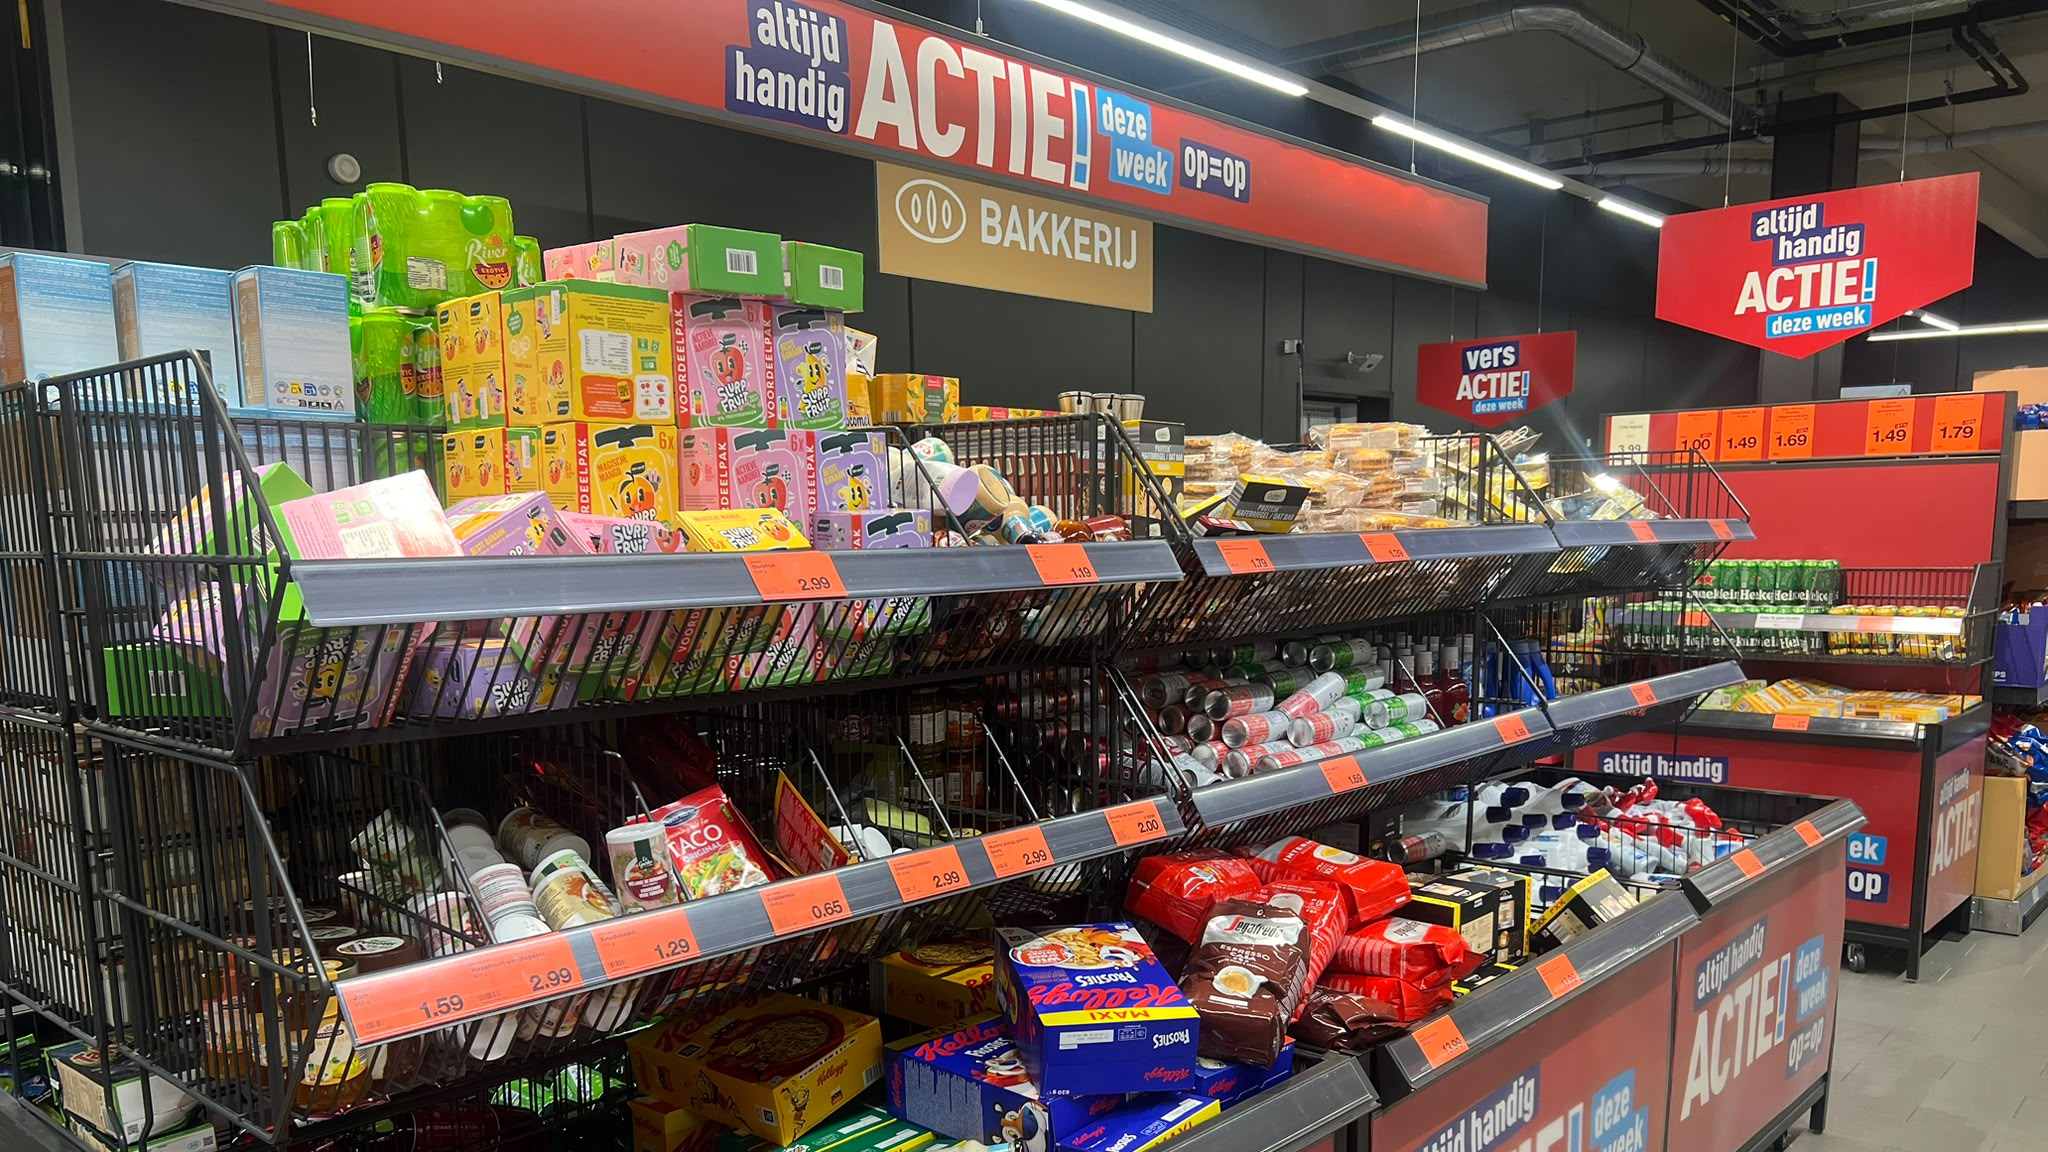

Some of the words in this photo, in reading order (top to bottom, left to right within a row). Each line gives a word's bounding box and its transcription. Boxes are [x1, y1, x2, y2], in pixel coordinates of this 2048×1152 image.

[755, 2, 840, 66] altijd
[735, 51, 846, 132] handig
[855, 19, 1091, 191] ACTIE!
[1101, 97, 1148, 141] deze
[1116, 146, 1168, 187] week
[1184, 145, 1246, 198] op=op
[1756, 203, 1818, 236] altijd
[980, 198, 1138, 270] BAKKERIJ
[1778, 227, 1861, 261] handig
[466, 238, 508, 270] River
[480, 266, 505, 275] EXOTIC
[1734, 257, 1877, 316] ACTIE!
[747, 306, 761, 323] 6x
[1772, 313, 1812, 336] deze
[1816, 306, 1865, 330] week
[830, 316, 842, 333] 6x
[673, 308, 690, 415] VOORDEELPAK
[1466, 344, 1516, 370] vers
[764, 317, 776, 420] VOORDEELPAK
[717, 379, 747, 398] SLURP
[1456, 371, 1529, 400] ACTIE!
[801, 387, 829, 406] SLURP
[1475, 401, 1496, 415] deze
[1498, 397, 1524, 413] week
[659, 432, 675, 450] 6x
[1776, 434, 1807, 447] 1.69
[1872, 429, 1907, 443] 1.49
[1940, 426, 1974, 439] 1.79
[790, 434, 804, 452] 6x
[872, 437, 884, 453] 6x
[1682, 439, 1711, 450] 1.00
[1726, 436, 1757, 450] 1.49
[597, 455, 628, 473] MAGISCHE
[599, 468, 622, 484] MANGO
[1257, 504, 1281, 513] PROTEIN
[612, 524, 649, 542] SLURP
[917, 516, 930, 533] 6x
[709, 538, 728, 550] 6x
[719, 526, 752, 544] SLURP
[1070, 566, 1092, 579] 1.19
[1251, 558, 1268, 569] 1.79
[798, 576, 831, 592] 2.99
[1603, 753, 1652, 776] altijd
[1657, 756, 1723, 784] handig
[1137, 819, 1160, 834] 2.00
[667, 824, 723, 858] TACO
[682, 842, 722, 863] ORIGINAL
[1022, 849, 1048, 866] 2.99
[932, 871, 961, 889] 2.99
[811, 900, 843, 920] 0.65
[1224, 915, 1283, 938] Segafred
[654, 938, 691, 960] 1.29
[1220, 944, 1270, 961] ESPRESSO
[1230, 952, 1256, 961] CASA
[1697, 952, 1726, 1000] altijd
[1729, 921, 1767, 983] handig
[1796, 945, 1821, 983] deze
[529, 967, 573, 992] 2.99
[1075, 972, 1137, 987] FROSTIES
[353, 992, 369, 1001] Jam
[1799, 974, 1827, 1016] week
[419, 994, 464, 1019] 1.59
[1090, 1009, 1150, 1021] MAXI
[924, 1021, 968, 1038] MAXI
[1153, 1029, 1190, 1049] FROSTIES
[1681, 952, 1791, 1121] ACTIE!
[965, 1038, 1010, 1057] FROSTIES
[1788, 1018, 1825, 1070] op=op
[816, 1060, 849, 1087] Kellogg's
[1144, 1067, 1190, 1082] Kellogg's
[1470, 1075, 1536, 1149] handig
[1594, 1089, 1630, 1138] deze
[1072, 1125, 1106, 1146] Kellogg's
